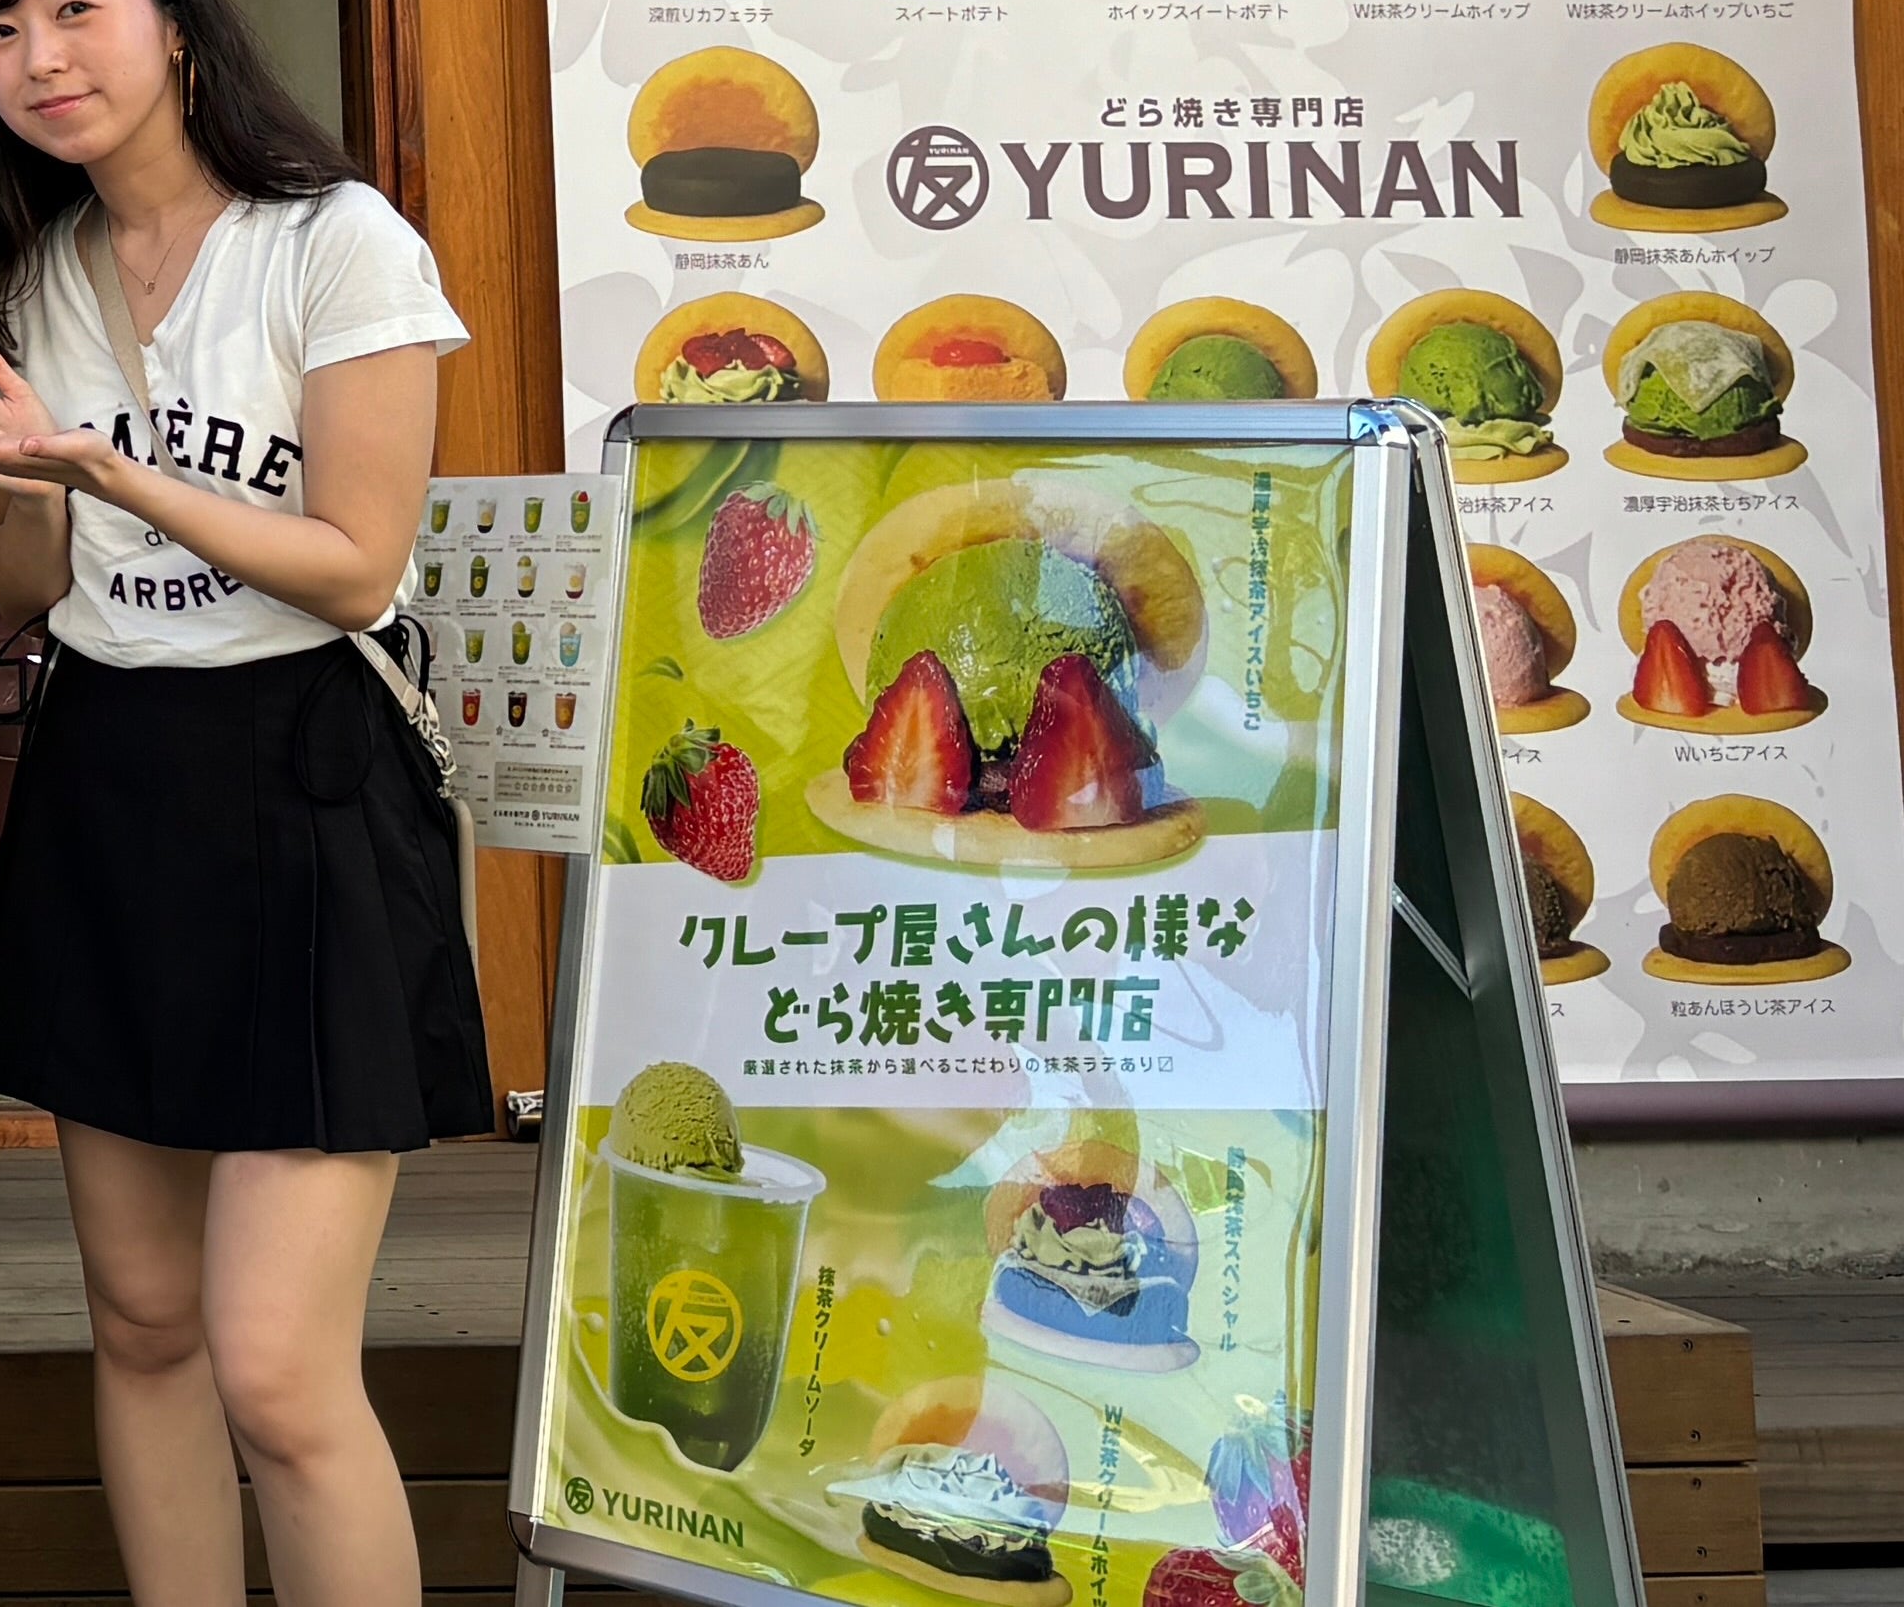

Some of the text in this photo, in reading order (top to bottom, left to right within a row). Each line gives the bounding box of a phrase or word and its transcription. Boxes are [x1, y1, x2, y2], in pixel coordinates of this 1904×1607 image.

[895, 5, 1009, 22] スイートポテト
[1108, 2, 1290, 21] ホイップスイートポテト
[1352, 2, 1531, 21] W抹茶クリームホイップ
[1566, 2, 1795, 20] W抹茶クリームホイップいちご
[1100, 95, 1365, 129] どら焼き専門店
[886, 125, 1525, 231] 友 YURINAN
[1674, 744, 1789, 763] Wいちごアイス
[678, 893, 1255, 971] クレープ屋さんの様な
[763, 974, 1161, 1046] どら焼き専門店
[798, 1265, 837, 1457] 抹茶クリームソーダ
[602, 1488, 744, 1548] YURINAN
